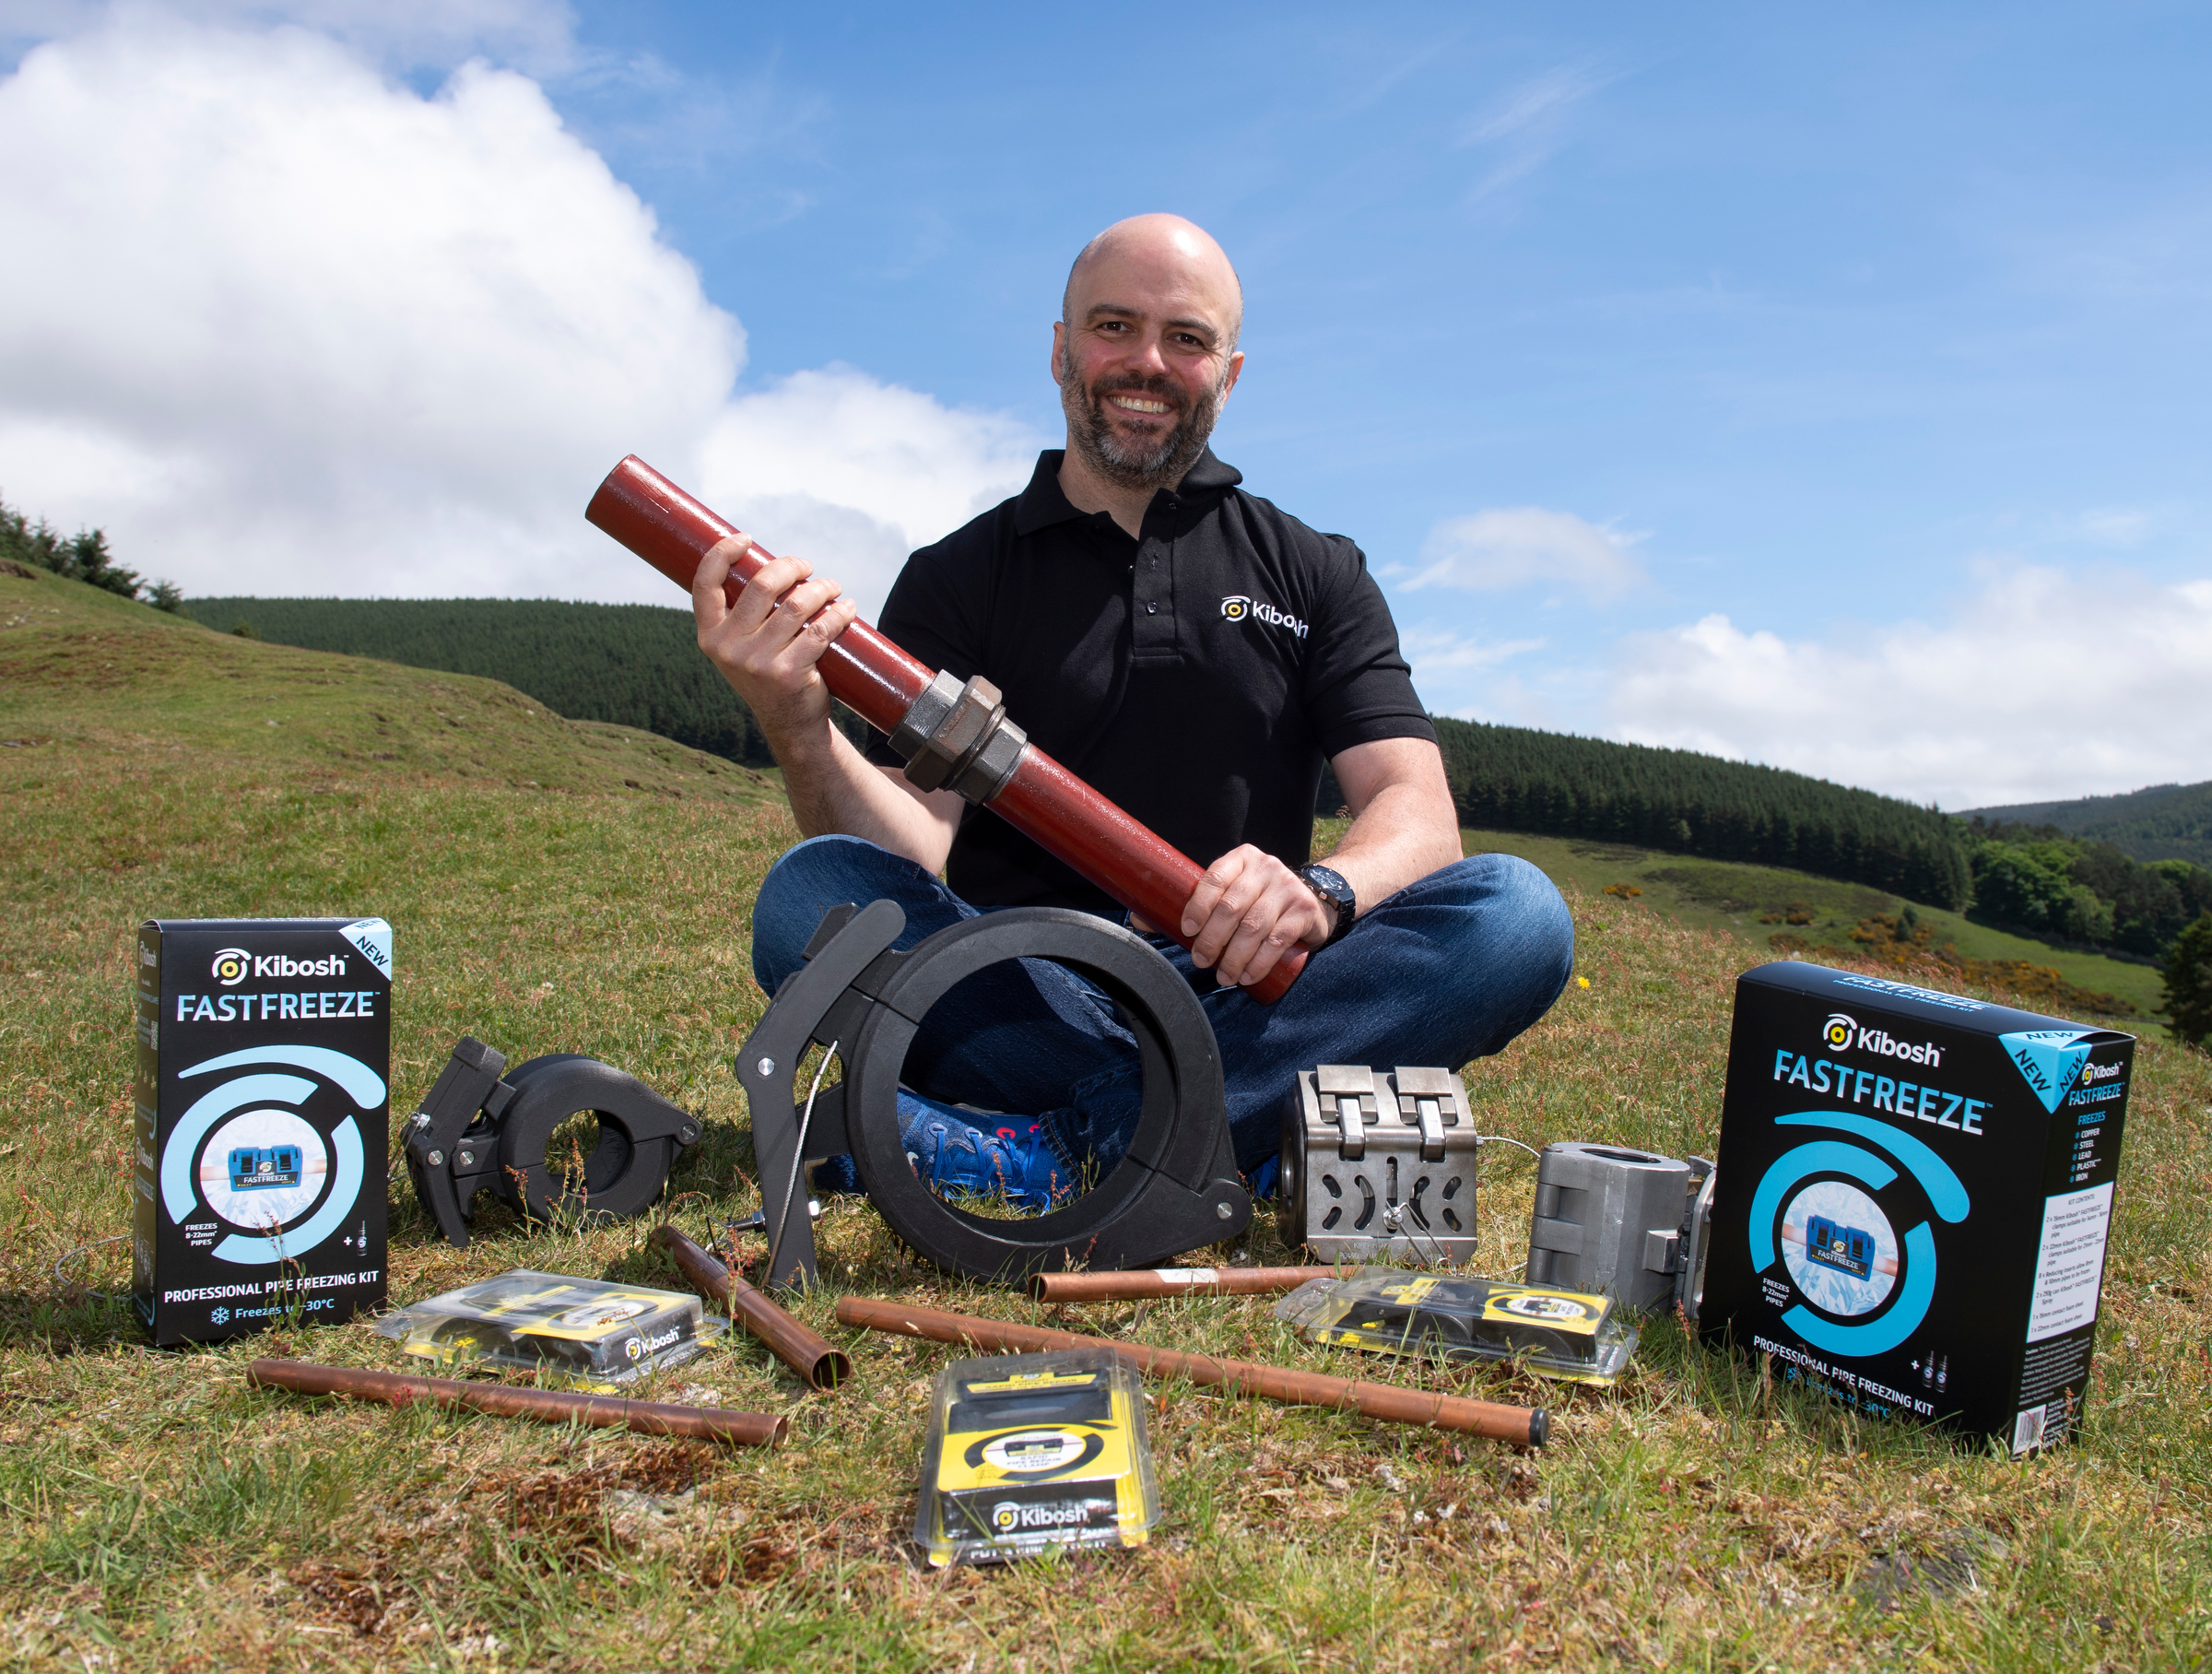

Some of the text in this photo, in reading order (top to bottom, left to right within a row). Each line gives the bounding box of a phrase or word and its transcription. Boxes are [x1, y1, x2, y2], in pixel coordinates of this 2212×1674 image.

[355, 918, 382, 929] NEW
[356, 936, 388, 967] NEW
[1833, 980, 1892, 995] PROFESSIONAL
[1915, 997, 1957, 1008] FREEZING
[2015, 1049, 2052, 1091] NEW
[2060, 1051, 2083, 1093] NEW
[2078, 1111, 2106, 1126] FREEZES
[2081, 1128, 2100, 1138] COPPER
[2079, 1139, 2094, 1149] STEEL
[2078, 1150, 2091, 1160] LEAD
[243, 1174, 288, 1183] FASTFREEZE
[2076, 1173, 2088, 1182] IRON
[1818, 1250, 1859, 1269] FASTFREEZE
[2048, 1250, 2062, 1258] clamps
[164, 1283, 262, 1303] PROFESSIONAL
[297, 1273, 356, 1290] FREEZING
[359, 1270, 380, 1283] KIT
[1762, 1278, 1790, 1292] FREEZES
[1766, 1296, 1783, 1307] PIPES
[235, 1307, 281, 1318] Freezes
[1754, 1335, 1934, 1416] PROFESSIONAL PIPE FREEZING KIT
[1021, 1504, 1088, 1527] Kibosh
